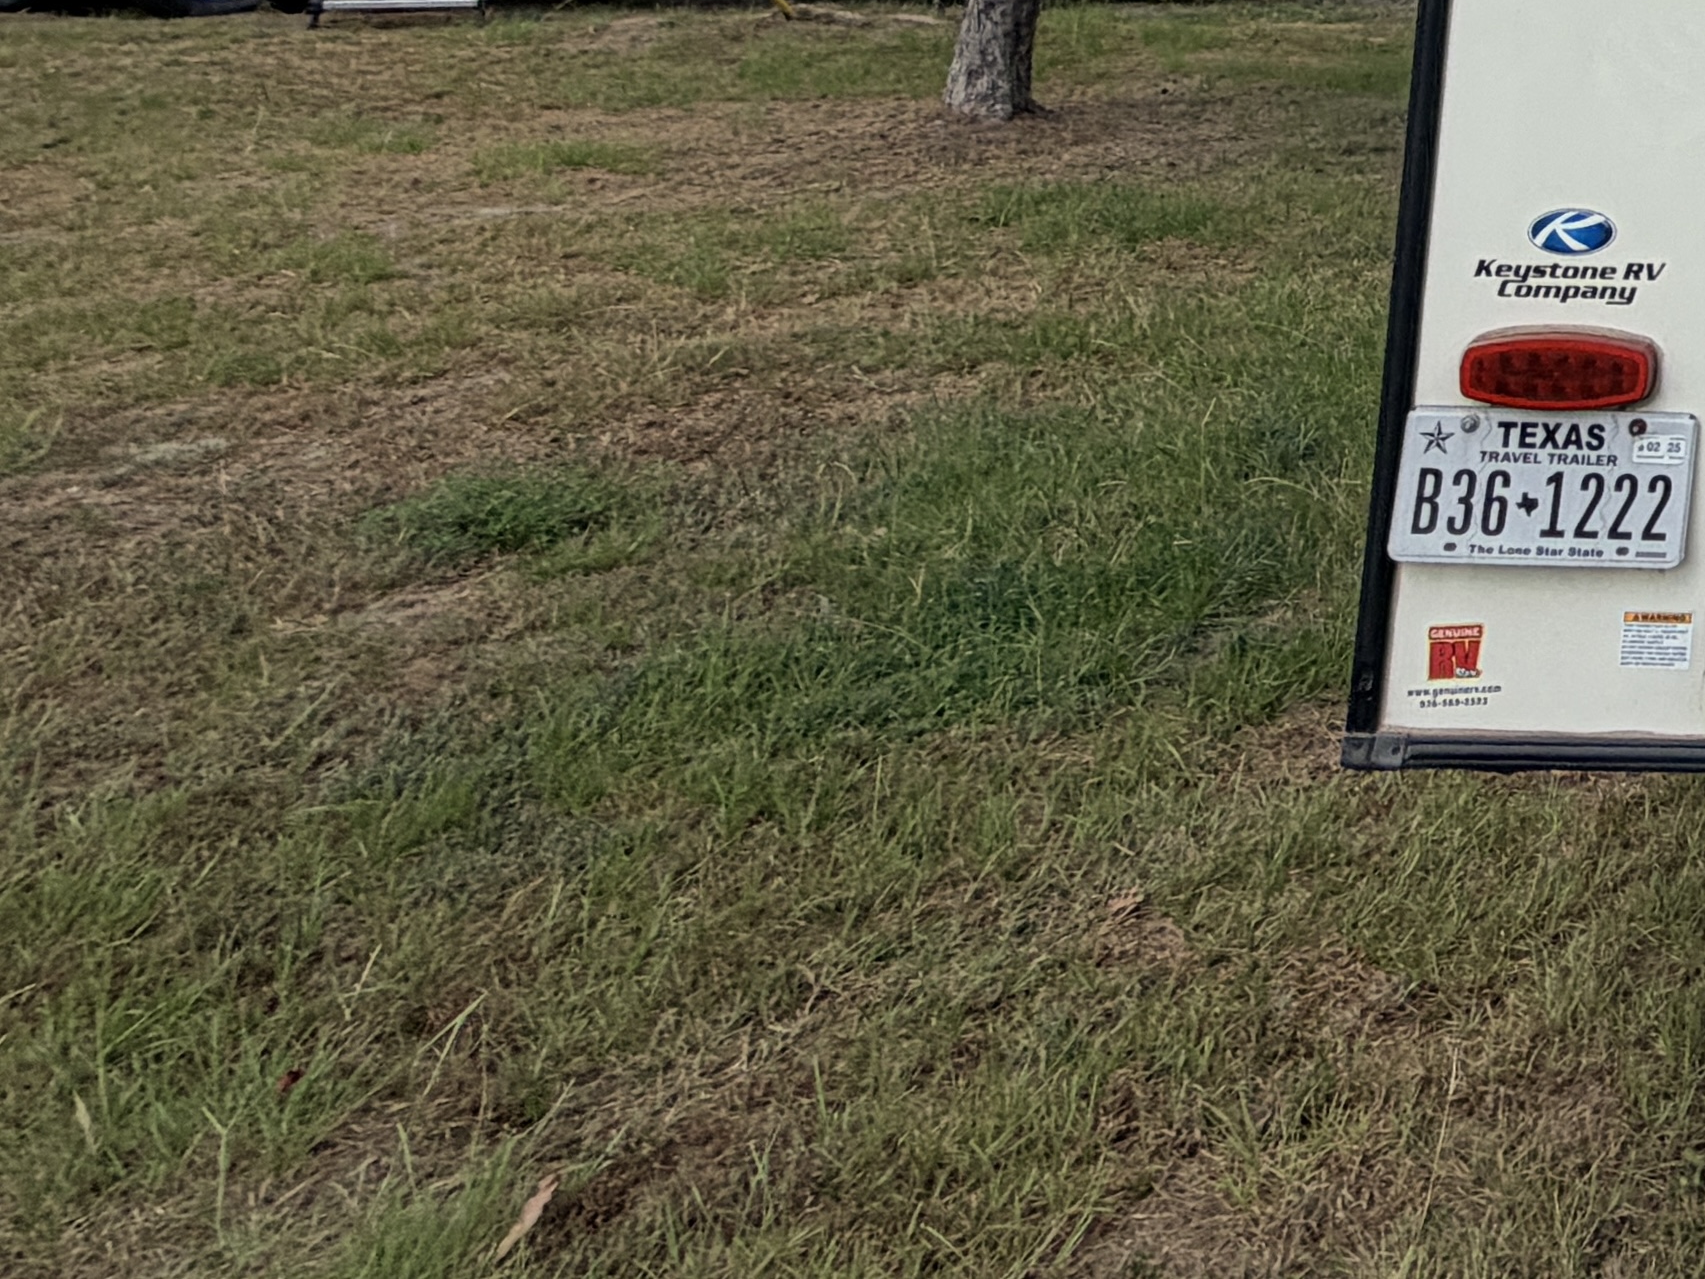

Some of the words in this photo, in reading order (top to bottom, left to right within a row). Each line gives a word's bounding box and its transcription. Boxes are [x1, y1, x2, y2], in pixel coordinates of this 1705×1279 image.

[1474, 259, 1617, 283] Keystone
[1622, 262, 1667, 281] RV
[1497, 279, 1638, 305] Company
[1497, 421, 1606, 451] TEXAS
[1646, 440, 1661, 453] 02
[1479, 450, 1542, 465] TRAVEL
[1547, 452, 1619, 467] TRAILER
[1410, 466, 1512, 537] B36
[1538, 470, 1674, 542] 1222
[1468, 543, 1494, 555] The
[1498, 545, 1532, 556] Lone
[1535, 545, 1564, 557] Star
[1567, 546, 1604, 558] State
[1430, 627, 1481, 639] GENUINE
[1429, 640, 1482, 680] RV
